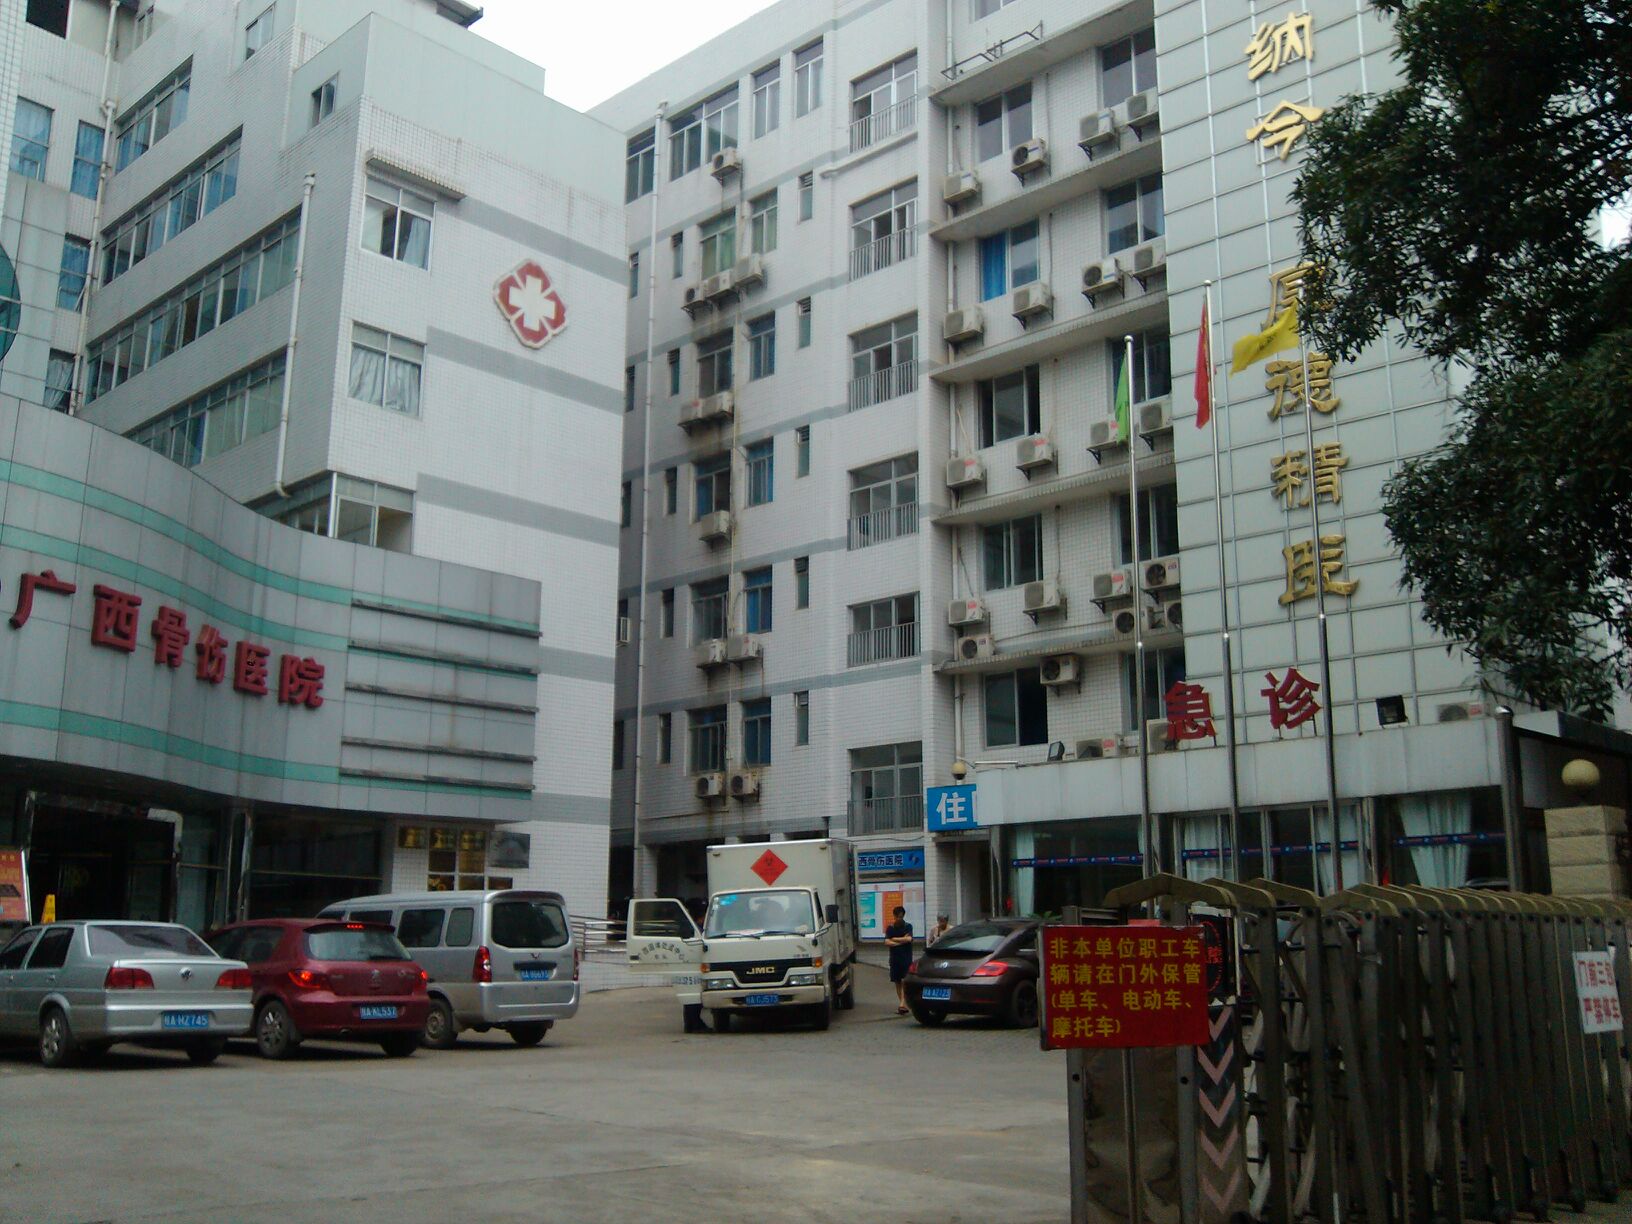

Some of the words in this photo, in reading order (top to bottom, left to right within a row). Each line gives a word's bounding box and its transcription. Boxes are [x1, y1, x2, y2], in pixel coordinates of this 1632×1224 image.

[9, 569, 325, 708] 广西骨伤医院
[1163, 666, 1322, 740] 急诊
[936, 791, 977, 825] 住
[1050, 937, 1200, 959] 非本单位职工车
[746, 966, 775, 975] JMC
[1050, 963, 1201, 985] 辆请在门外保管
[1052, 1016, 1121, 1038] 摩托车)
